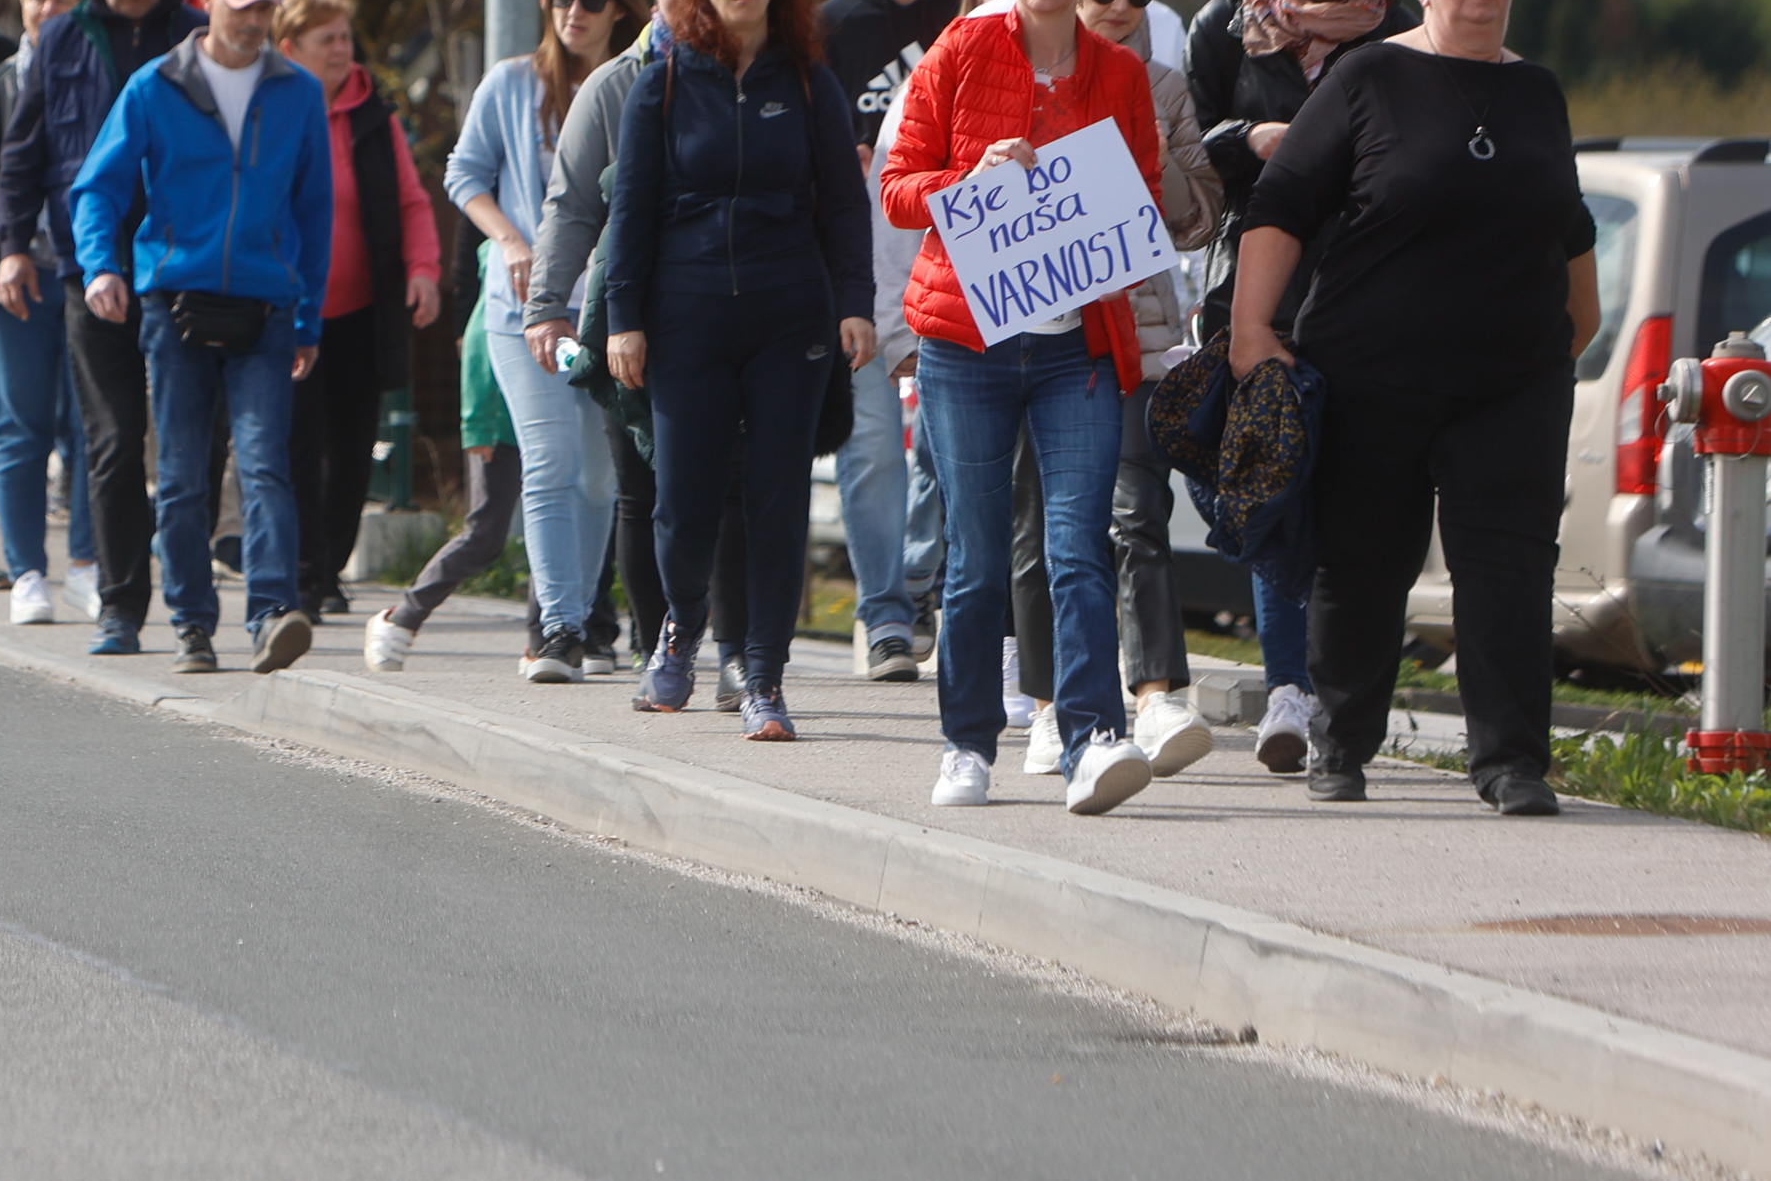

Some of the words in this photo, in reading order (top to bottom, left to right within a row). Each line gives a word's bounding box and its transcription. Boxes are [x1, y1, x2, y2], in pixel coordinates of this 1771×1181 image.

[940, 184, 1008, 241] Kje
[1027, 156, 1072, 195] bo
[989, 192, 1088, 253] naša
